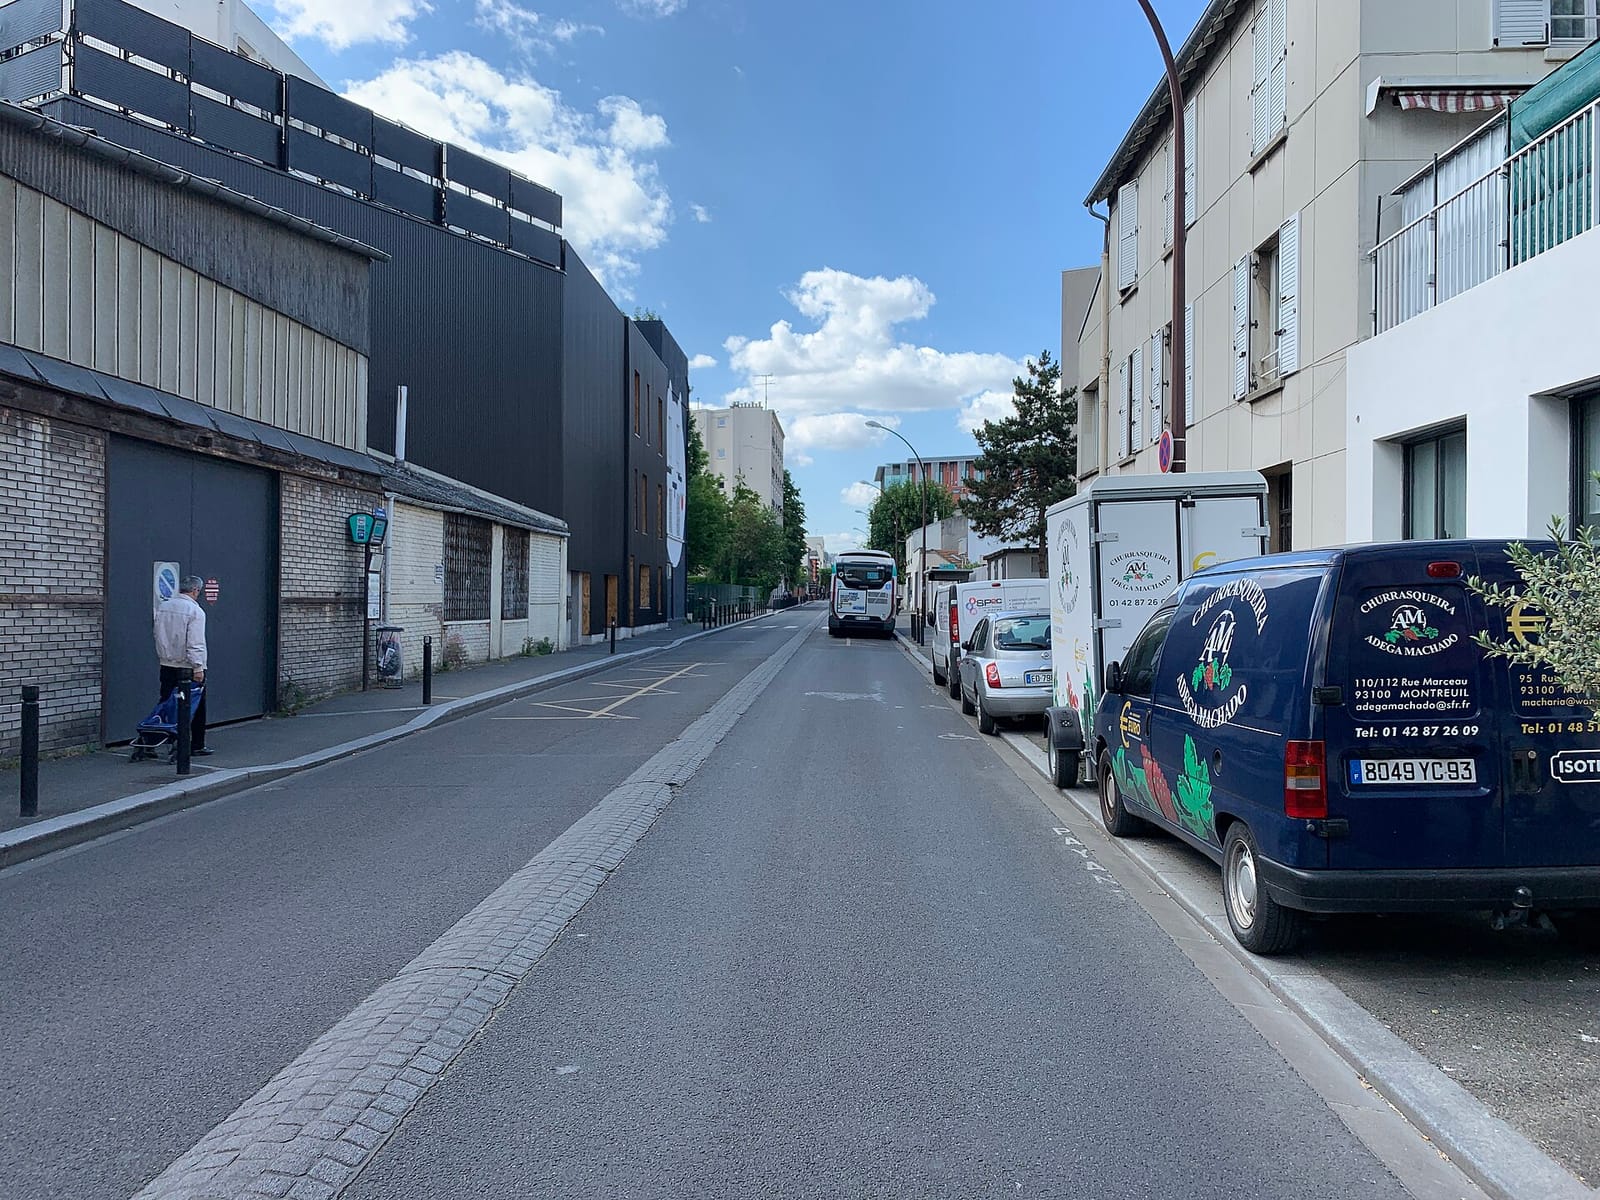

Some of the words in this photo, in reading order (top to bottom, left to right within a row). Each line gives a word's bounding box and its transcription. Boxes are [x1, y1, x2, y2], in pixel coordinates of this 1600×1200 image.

[1110, 551, 1171, 566] CHURRASQUEIRA
[1110, 577, 1133, 591] ADEGA
[1134, 574, 1171, 592] MACHADO
[1109, 599, 1119, 607] 01
[1121, 599, 1132, 607] 42
[1134, 598, 1145, 606] 87
[1147, 598, 1159, 606] 26
[1191, 577, 1269, 636] CHURRASQUEIRA
[1360, 590, 1456, 616] CHURRASQUEIRA
[1390, 609, 1425, 629] AM
[1198, 621, 1237, 663] AM
[1364, 634, 1403, 655] ADEGA
[1404, 633, 1459, 656] MACHADO
[1355, 679, 1399, 687] 110/112
[1401, 678, 1420, 686] Rue
[1422, 678, 1468, 686] Marceau
[1519, 675, 1533, 683] 95
[1355, 690, 1391, 699] 93100
[1400, 689, 1469, 698] MONTREUIL
[1520, 686, 1555, 695] 93100
[1176, 673, 1198, 722] ADEGA
[1197, 684, 1248, 729] MACHADO
[1355, 700, 1470, 712] adegamachado@sfr.fr
[1355, 727, 1378, 738] Tel:
[1382, 727, 1397, 736] 01
[1402, 726, 1419, 736] 42
[1422, 726, 1439, 736] 87
[1442, 725, 1459, 736] 26
[1462, 725, 1479, 735] 09
[1521, 723, 1544, 734] Tel:
[1548, 723, 1563, 733] 01
[1567, 722, 1583, 733] 48
[1365, 762, 1416, 781] 8049
[1418, 762, 1444, 781] YC
[1447, 761, 1473, 780] 93
